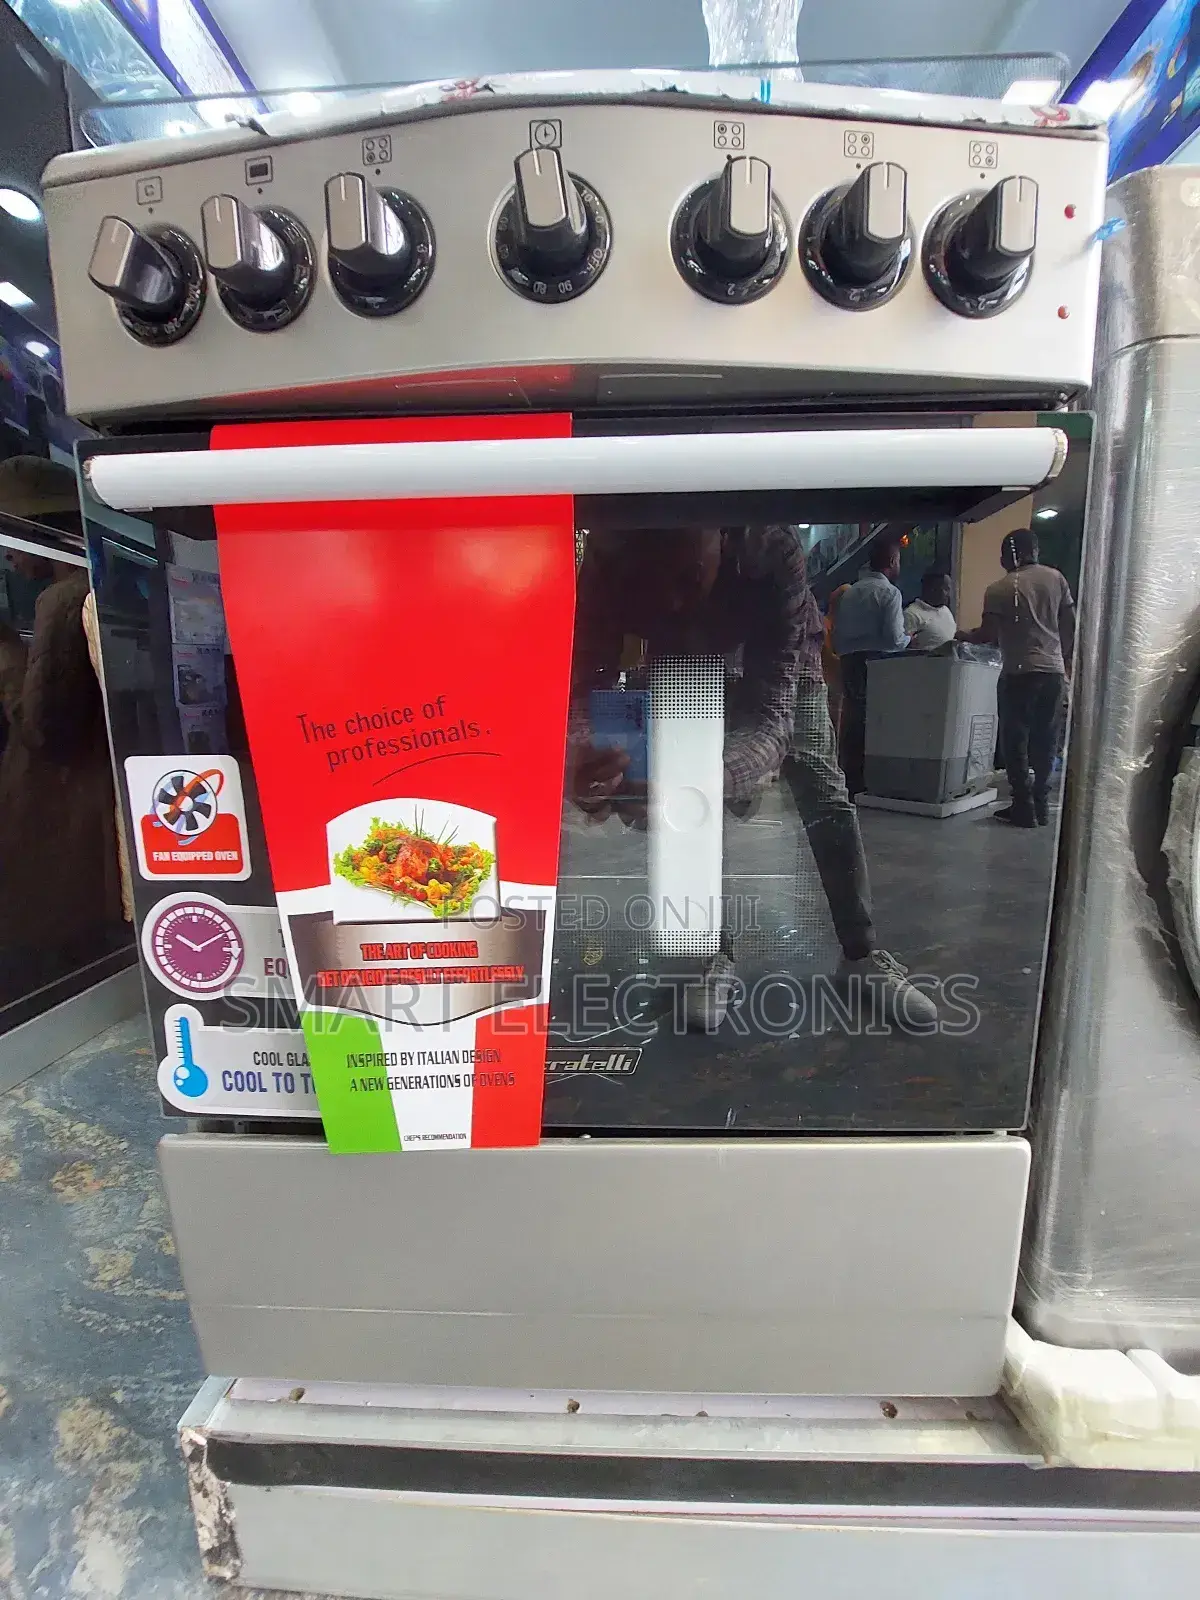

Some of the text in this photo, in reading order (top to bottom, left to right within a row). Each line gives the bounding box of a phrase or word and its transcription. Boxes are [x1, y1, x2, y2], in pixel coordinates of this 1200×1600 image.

[296, 694, 447, 743] The choice of
[326, 719, 492, 772] professionals.
[152, 851, 239, 862] FAN EQUIPPED OVEN
[360, 940, 479, 961] THE ART OF COOKING
[253, 1051, 283, 1066] COOL
[346, 1048, 502, 1068] INSPIRED BY ITALIAN DESIGN
[544, 1054, 632, 1071] ratelli
[222, 1070, 267, 1092] COOL
[272, 1072, 295, 1094] TO
[350, 1072, 516, 1092] A NEW GENERATIONS OF OVENS
